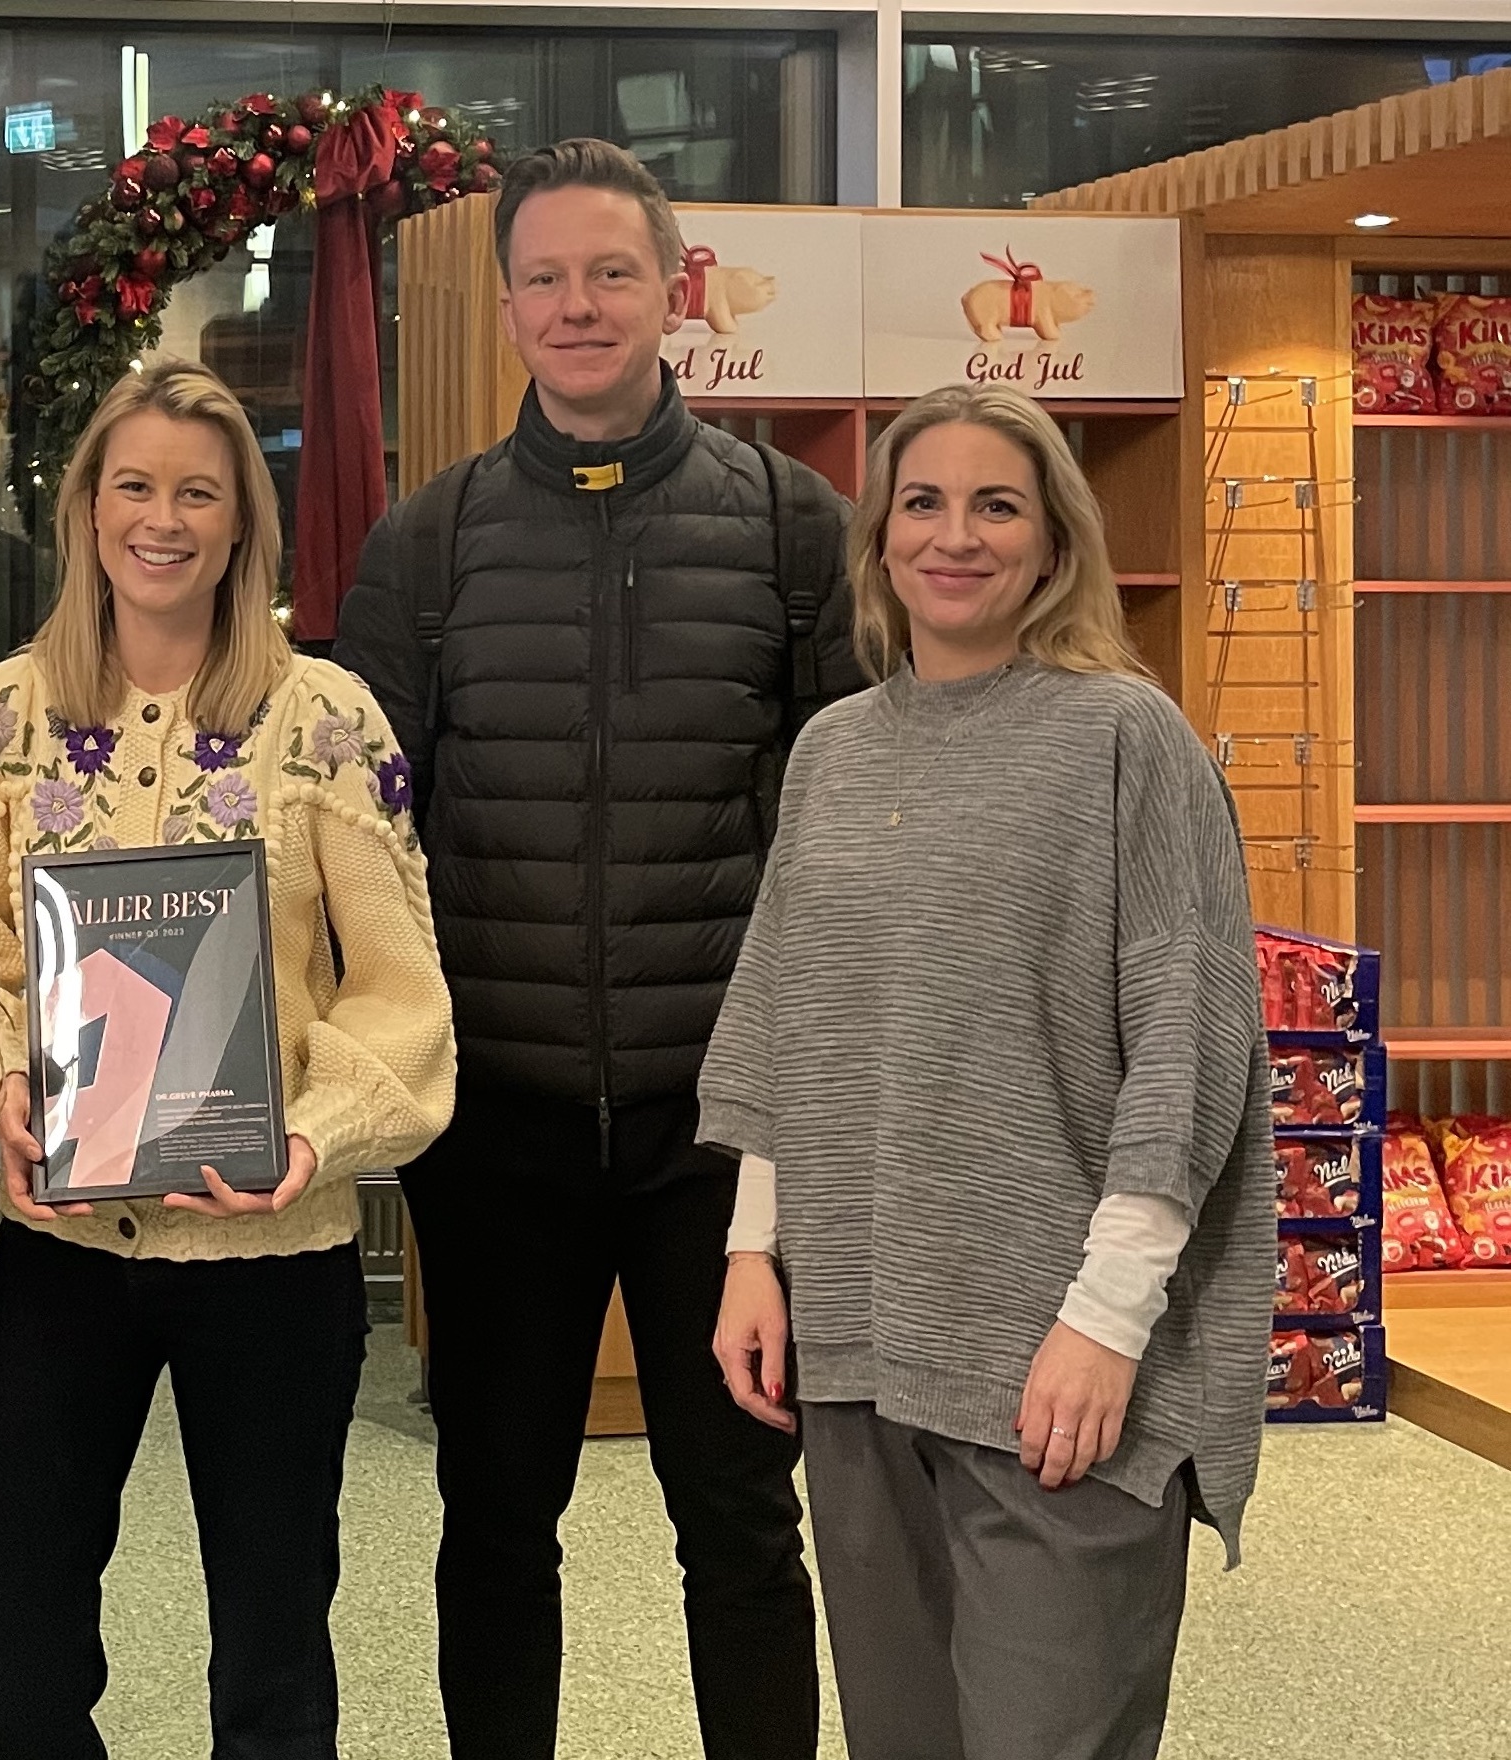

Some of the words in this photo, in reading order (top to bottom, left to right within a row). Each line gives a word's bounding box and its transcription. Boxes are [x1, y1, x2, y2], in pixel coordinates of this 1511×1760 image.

[705, 348, 764, 391] Jul
[965, 352, 1025, 388] God
[1033, 352, 1084, 391] Jul
[161, 888, 236, 920] BEST
[198, 1088, 235, 1099] PHARMA
[1313, 1154, 1351, 1184] Nid
[1317, 1247, 1358, 1274] Nida
[1322, 1342, 1361, 1372] Nida
